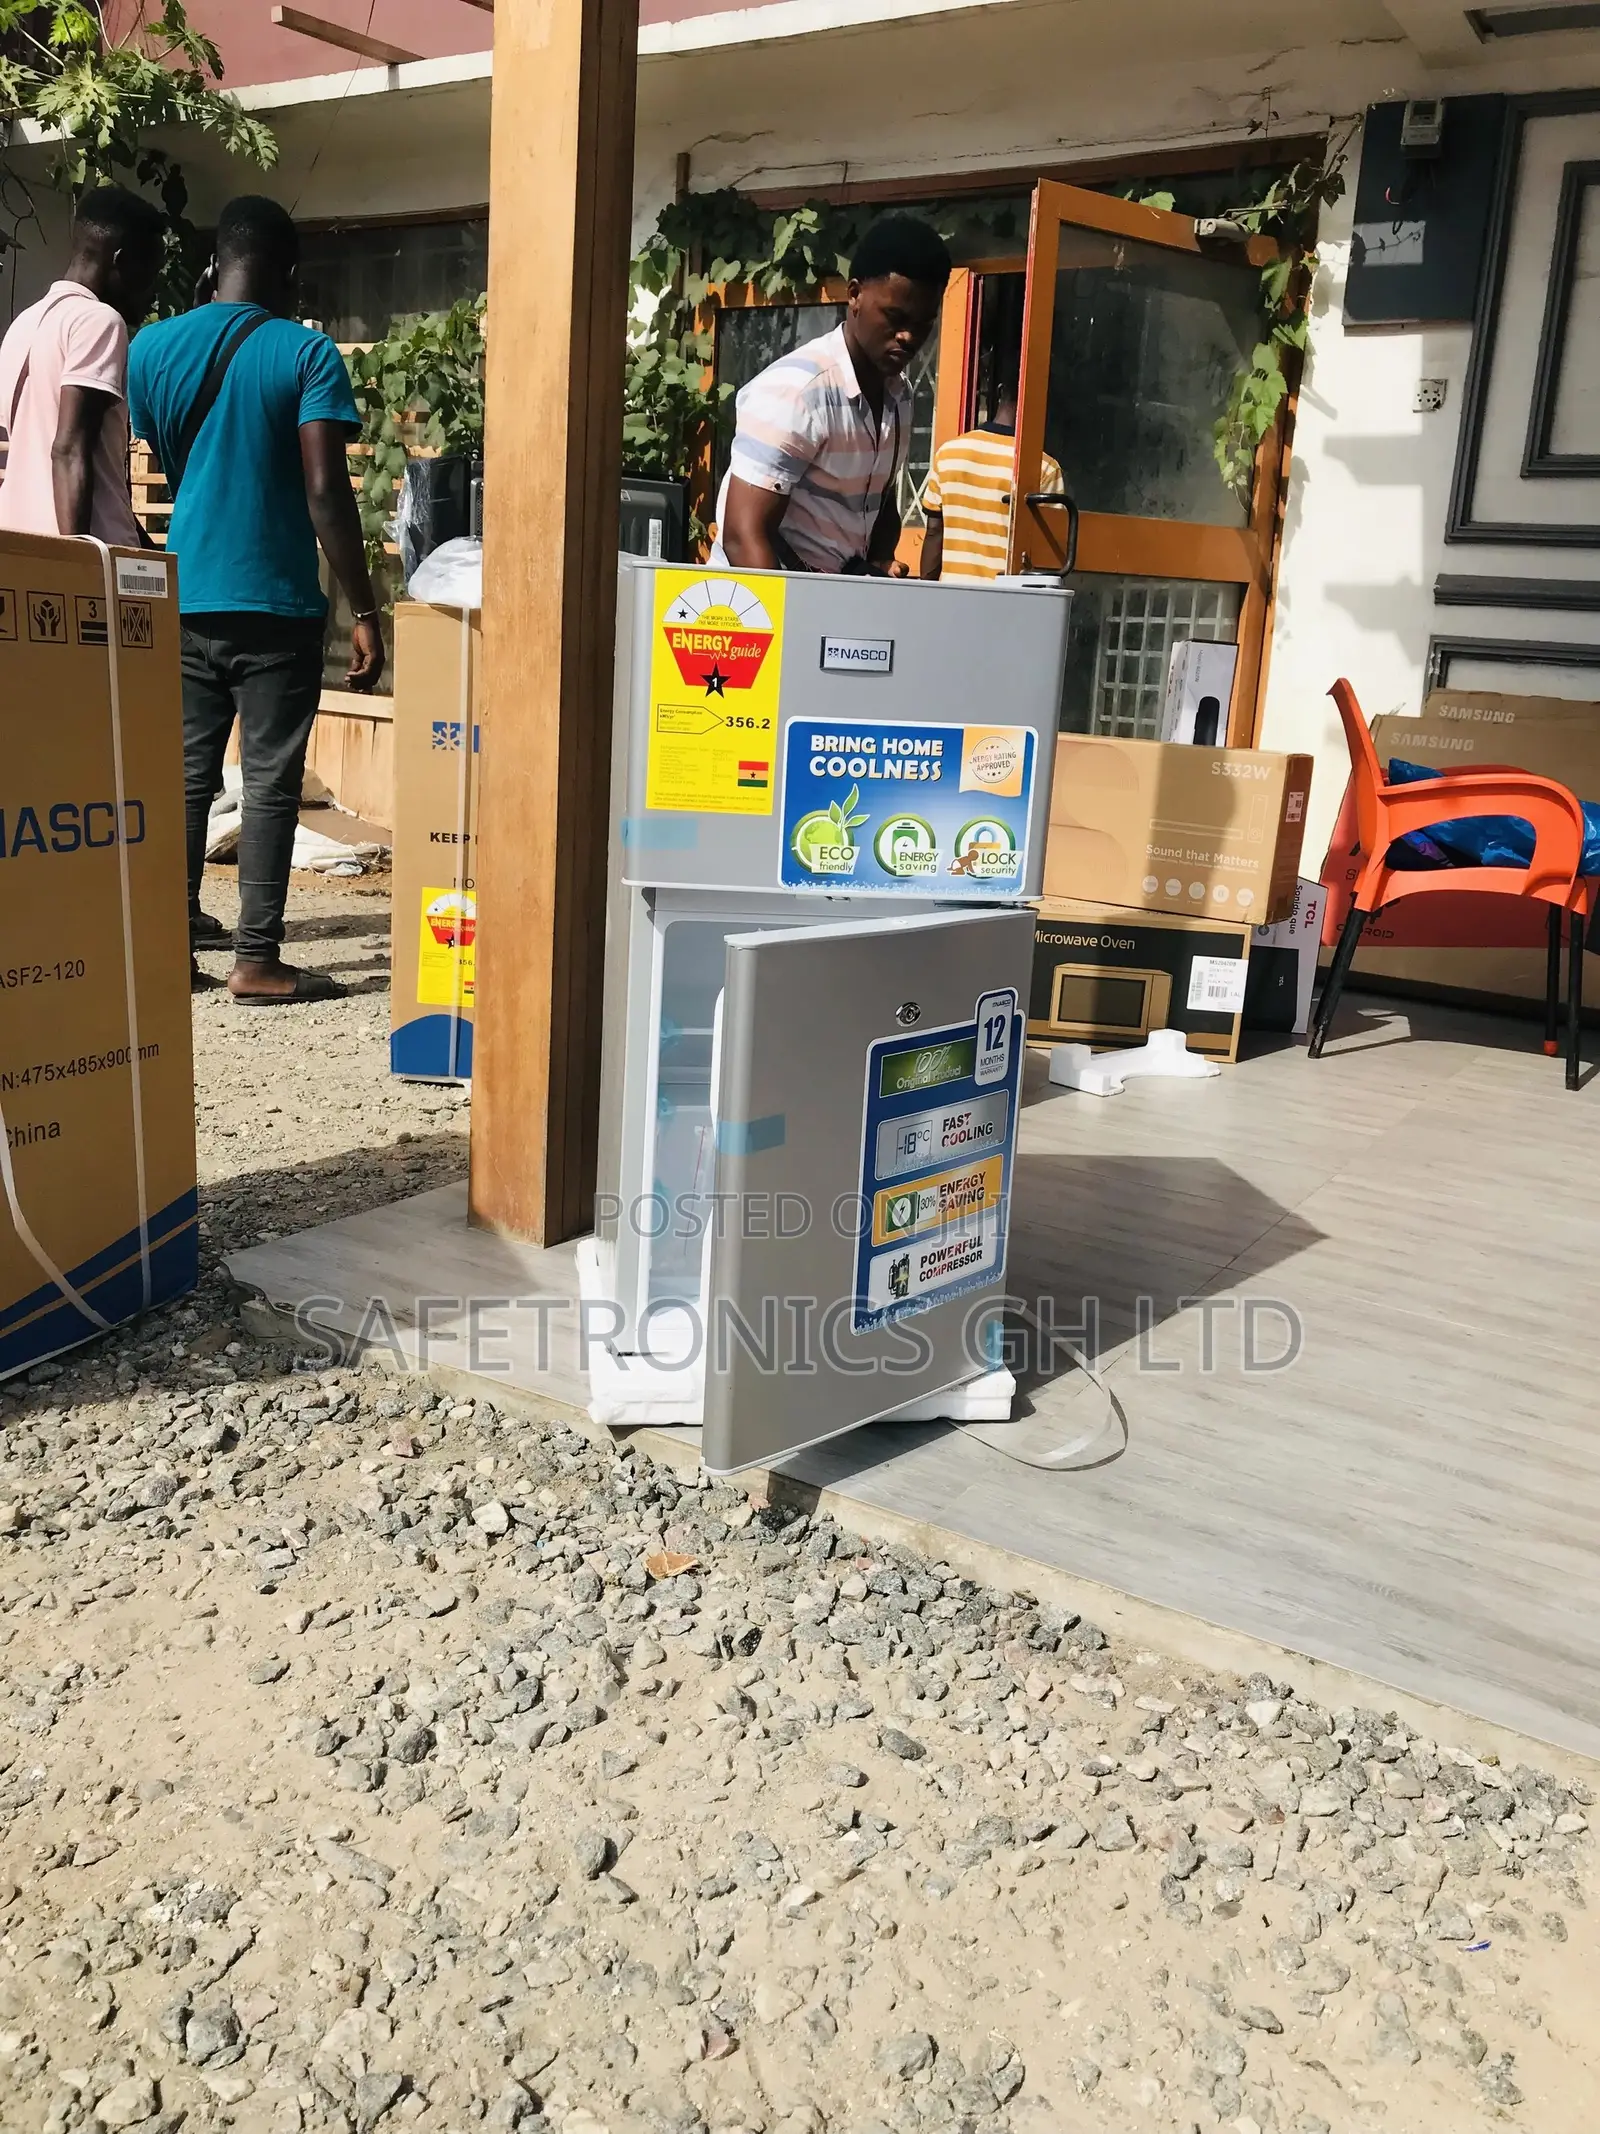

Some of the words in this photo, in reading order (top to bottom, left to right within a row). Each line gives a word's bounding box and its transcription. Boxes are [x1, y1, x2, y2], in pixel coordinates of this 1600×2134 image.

[88, 600, 98, 619] 3
[672, 628, 732, 655] ENERGY
[729, 643, 762, 661] guide
[840, 648, 887, 661] NASCO
[711, 677, 718, 688] 1
[725, 715, 771, 730] 356.2
[1438, 704, 1516, 724] SAMSUNG
[810, 734, 877, 755] BRING
[882, 736, 944, 758] HOME
[1390, 732, 1475, 752] SAMSUNG
[809, 755, 943, 781] COOLNESS
[969, 754, 993, 766] NERGY
[976, 759, 1012, 772] APPROVED
[1211, 761, 1271, 781] S332W
[0, 800, 145, 858] ASCO
[819, 846, 854, 861] ECO
[899, 852, 938, 863] ENERGY
[981, 853, 1016, 865] LOCK
[1145, 844, 1182, 859] Sound
[1186, 849, 1210, 862] that
[1213, 853, 1260, 869] Matters
[819, 860, 853, 873] friendly
[899, 862, 937, 874] saving
[981, 864, 1017, 876] security
[1292, 885, 1303, 916] Sonido
[430, 916, 461, 930] ENERG
[1304, 900, 1317, 929] TCL
[1289, 917, 1297, 935] que
[1100, 935, 1136, 950] Oven
[983, 1014, 1006, 1052] 12
[980, 1053, 1005, 1068] MONTHS
[896, 1070, 931, 1090] Original
[931, 1064, 962, 1083] Product
[979, 1066, 1004, 1077] WARRANTY
[942, 1112, 972, 1132] FAST
[941, 1122, 994, 1148] COOLING
[939, 1171, 987, 1199] ENERGY
[937, 1186, 985, 1214] SAVING
[919, 1235, 984, 1269] POWERFUL
[918, 1249, 984, 1283] COMPRESSOR
